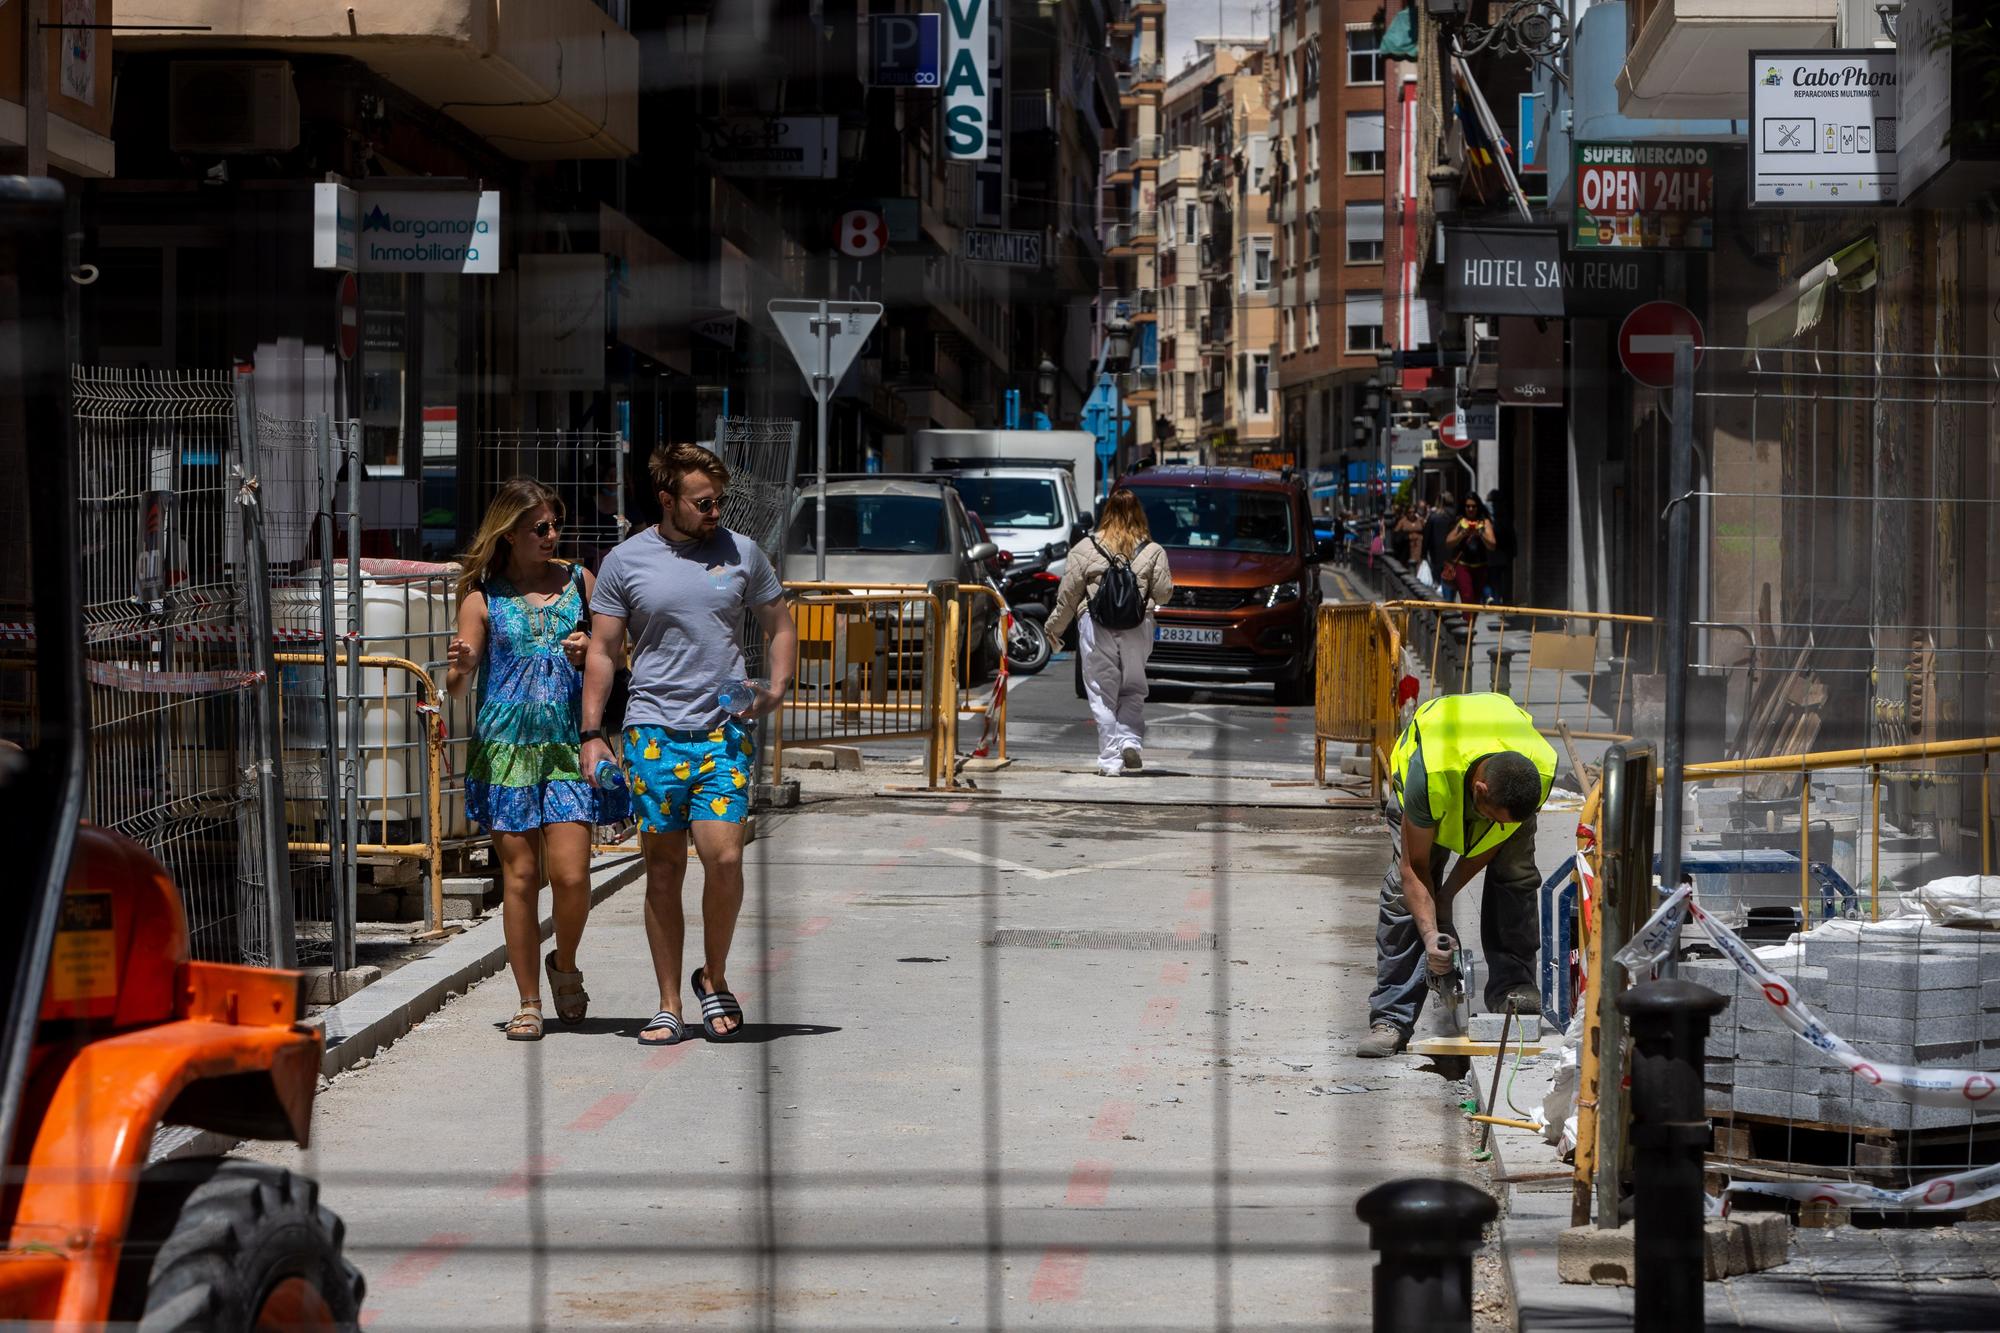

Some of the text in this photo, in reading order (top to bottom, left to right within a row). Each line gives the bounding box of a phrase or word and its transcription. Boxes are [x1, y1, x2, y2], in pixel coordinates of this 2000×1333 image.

[880, 17, 919, 67] P
[1793, 89, 1880, 98] REPARACIONES MULTIMARCA
[1583, 146, 1708, 165] SUPERMERCADO
[1582, 168, 1707, 211] OPEN 24H.
[362, 203, 489, 239] Margamora
[370, 242, 480, 261] Inmobiliaria
[967, 231, 1039, 263] CERVANTES
[1465, 259, 1639, 290] HOTEL SAN REMO
[702, 322, 733, 336] ATM
[1513, 383, 1546, 397] sagoa
[1162, 629, 1219, 642] 2832 LKK
[1643, 905, 1677, 954] ALTO
